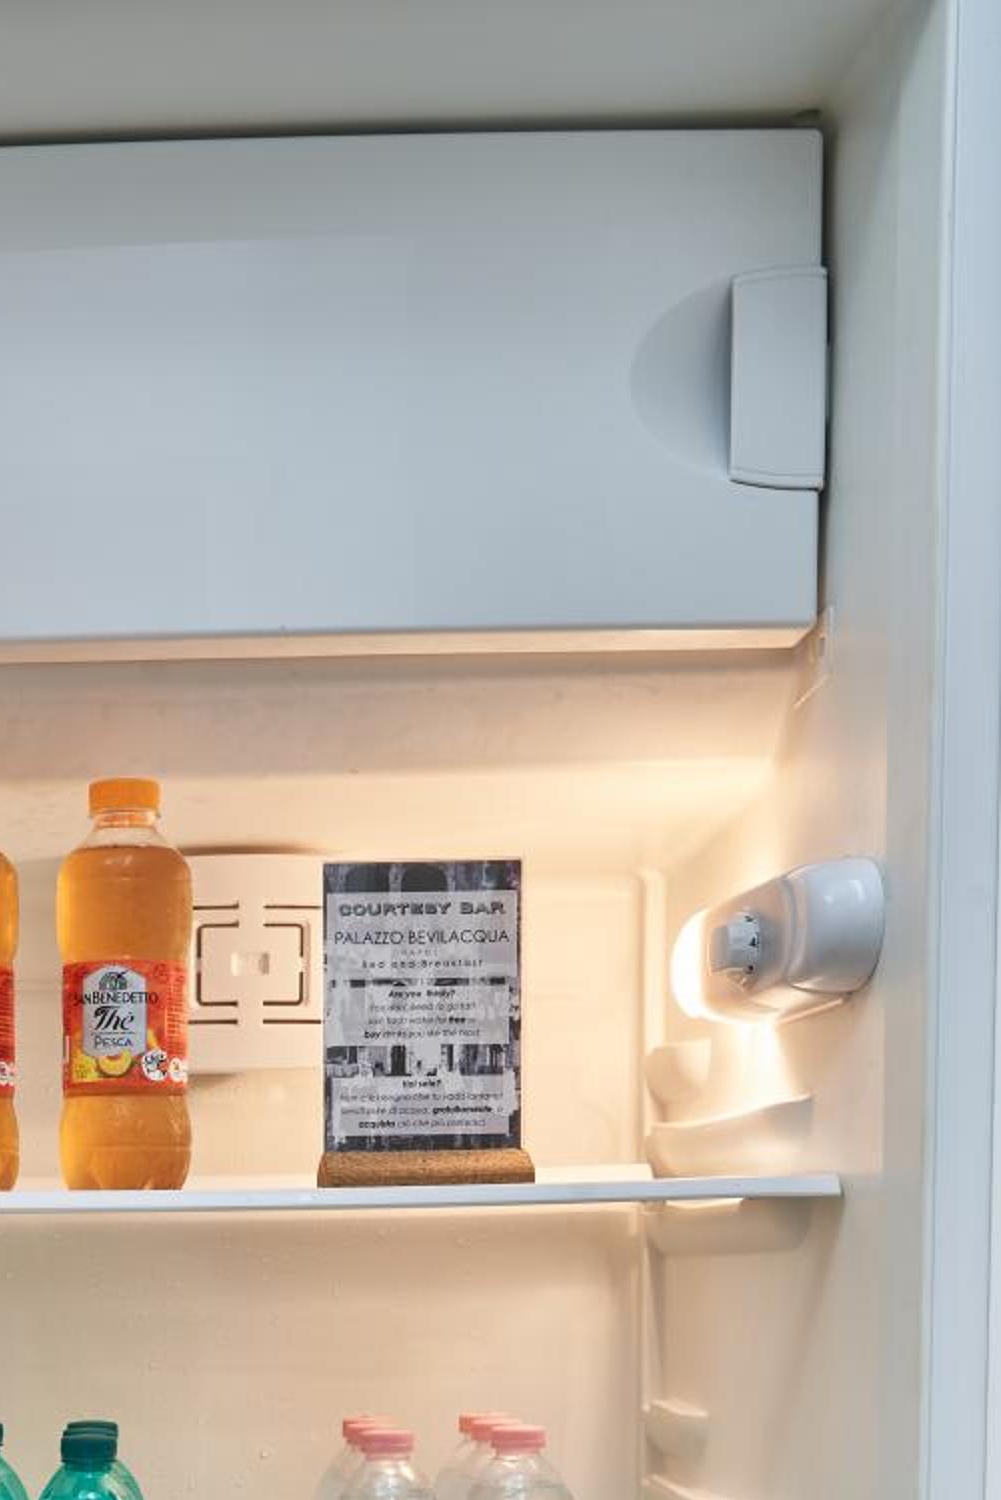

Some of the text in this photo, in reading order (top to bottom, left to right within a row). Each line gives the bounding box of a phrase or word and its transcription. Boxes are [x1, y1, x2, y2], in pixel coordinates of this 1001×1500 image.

[339, 901, 507, 917] COURTESY BAR
[334, 929, 510, 945] PALAZZO BEVILACQUA
[94, 1035, 132, 1048] PESCA
